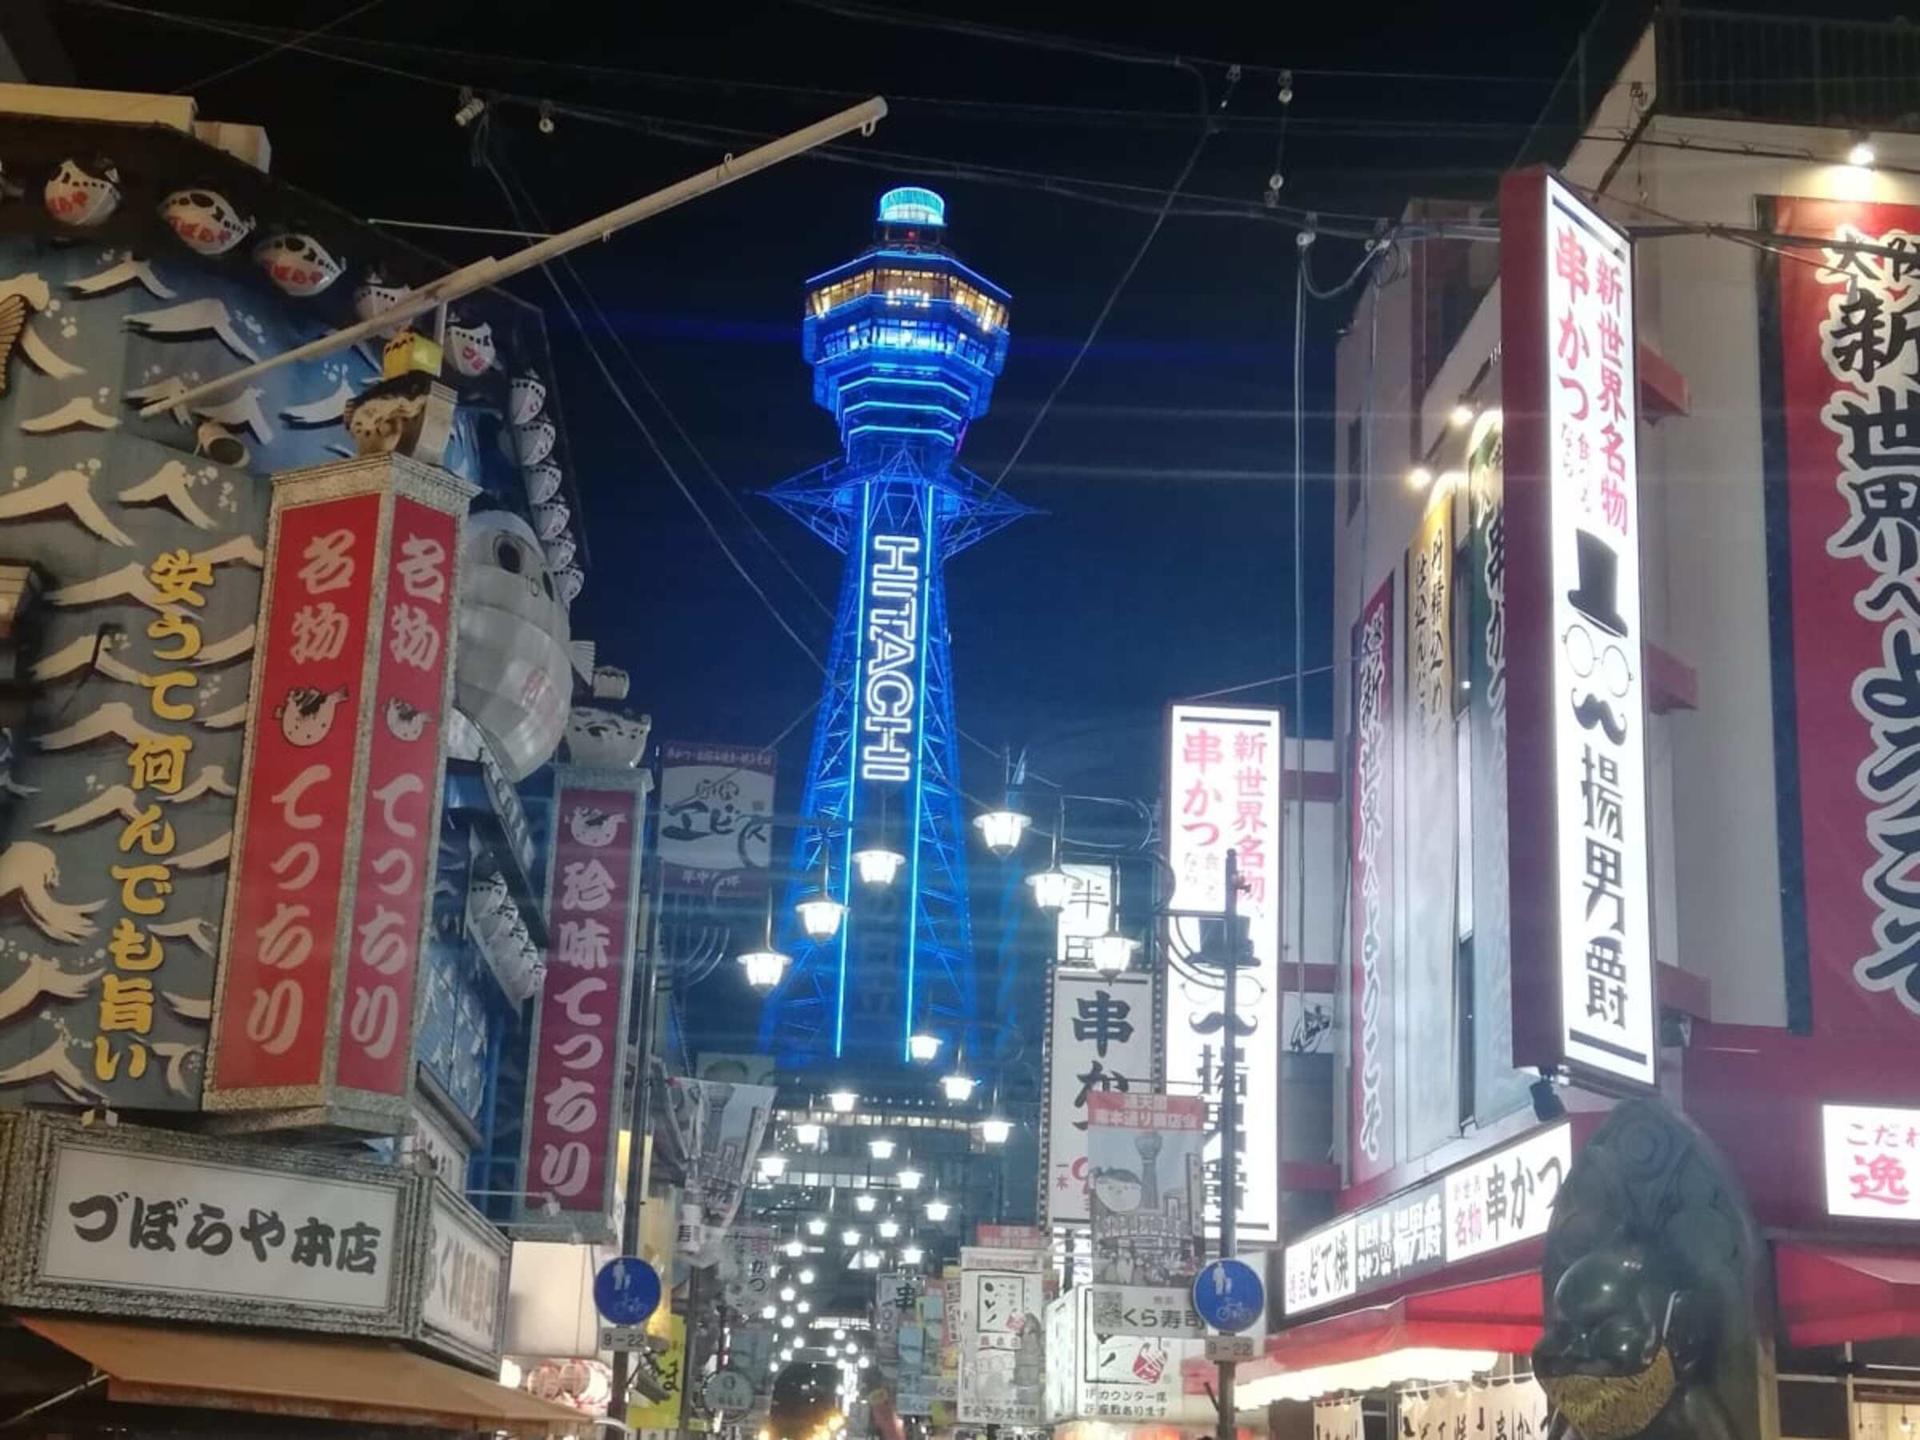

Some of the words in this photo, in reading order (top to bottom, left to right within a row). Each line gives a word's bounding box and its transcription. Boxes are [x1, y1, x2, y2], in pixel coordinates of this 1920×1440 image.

[1554, 226, 1590, 422] 串かつ
[1595, 256, 1629, 537] 新世界名物
[289, 528, 356, 665] 名物
[389, 532, 446, 672] 名物
[862, 535, 920, 782] HITACHI
[94, 548, 213, 1082] 安うて何んでも旨い
[245, 765, 333, 1056] てっちり
[1181, 729, 1224, 846] 串かつ
[349, 772, 425, 1061] てっちり
[541, 859, 617, 1197] 珍味てっちり
[69, 1192, 382, 1274] づぼらや本店
